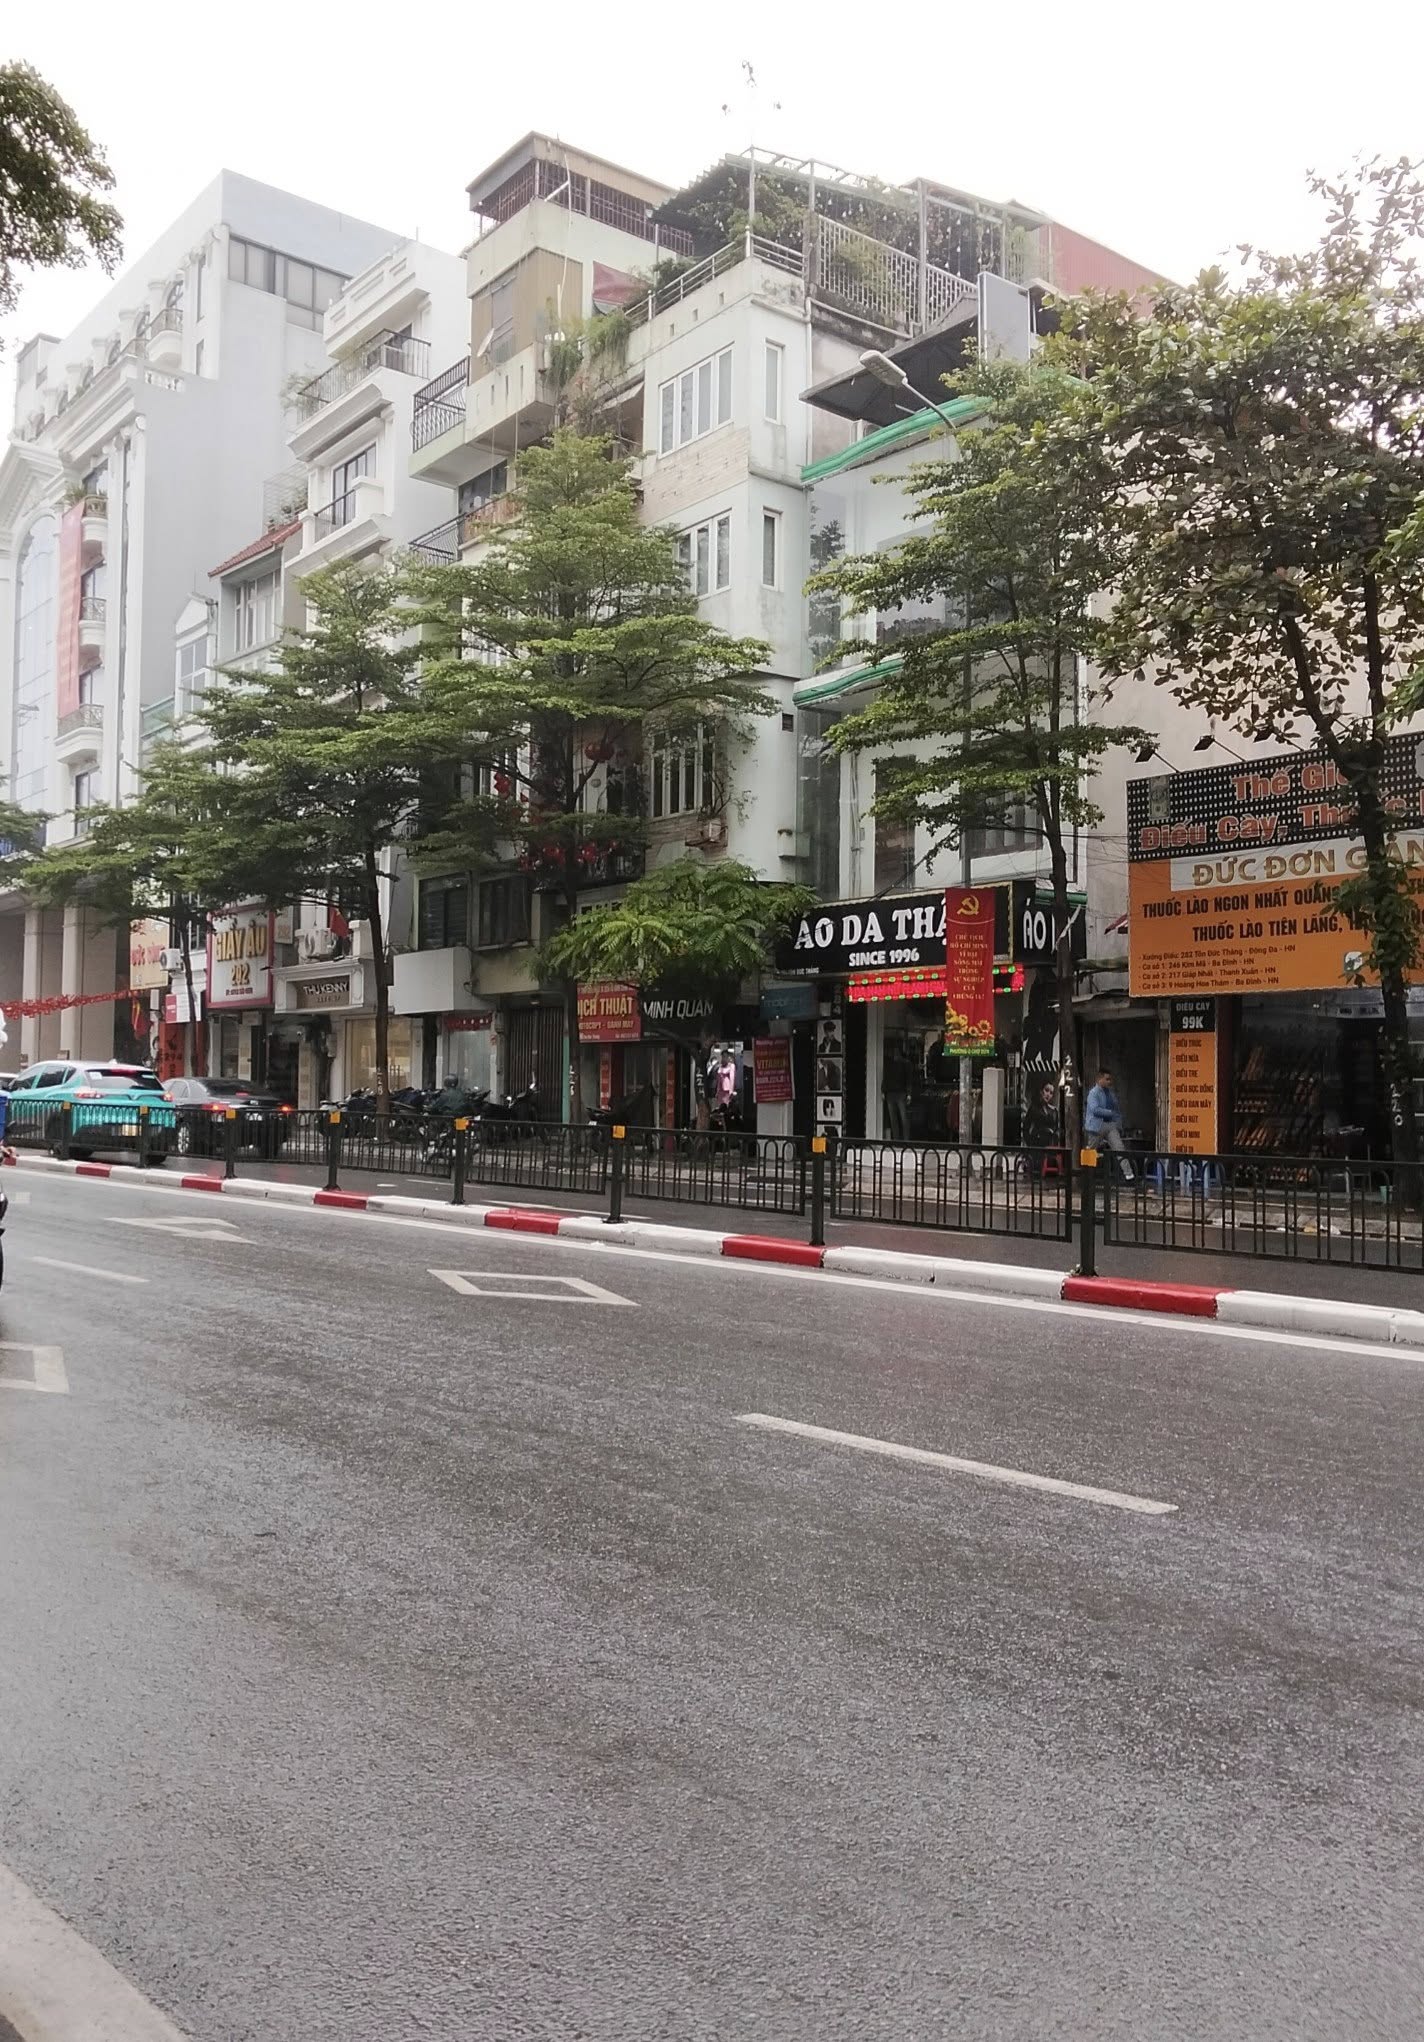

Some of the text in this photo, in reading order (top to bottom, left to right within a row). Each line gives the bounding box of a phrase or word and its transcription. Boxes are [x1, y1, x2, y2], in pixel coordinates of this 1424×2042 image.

[1231, 764, 1295, 801] Thế
[1139, 819, 1208, 851] Điếu
[1216, 813, 1288, 843] Cày,
[1192, 857, 1257, 886] ĐỨC
[1263, 849, 1336, 880] ĐƠN
[1142, 898, 1182, 919] THUỐC
[1186, 899, 1209, 915] LÀO
[1214, 896, 1249, 913] NGON
[1254, 885, 1288, 910] NHẤT
[840, 911, 885, 946] DA
[1022, 897, 1047, 950] ÁO
[1192, 920, 1234, 942] THUỐC
[1239, 920, 1263, 940] LÀO
[1268, 916, 1297, 937] TIÊN
[246, 919, 268, 960] ÂU
[848, 948, 920, 967] SINCE 1996
[1243, 957, 1255, 965] HN
[1265, 966, 1276, 974] HN
[1267, 976, 1279, 984] HN
[599, 993, 634, 1017] THUẬT
[643, 1000, 674, 1019] MINH
[1182, 1015, 1204, 1029] 99K
